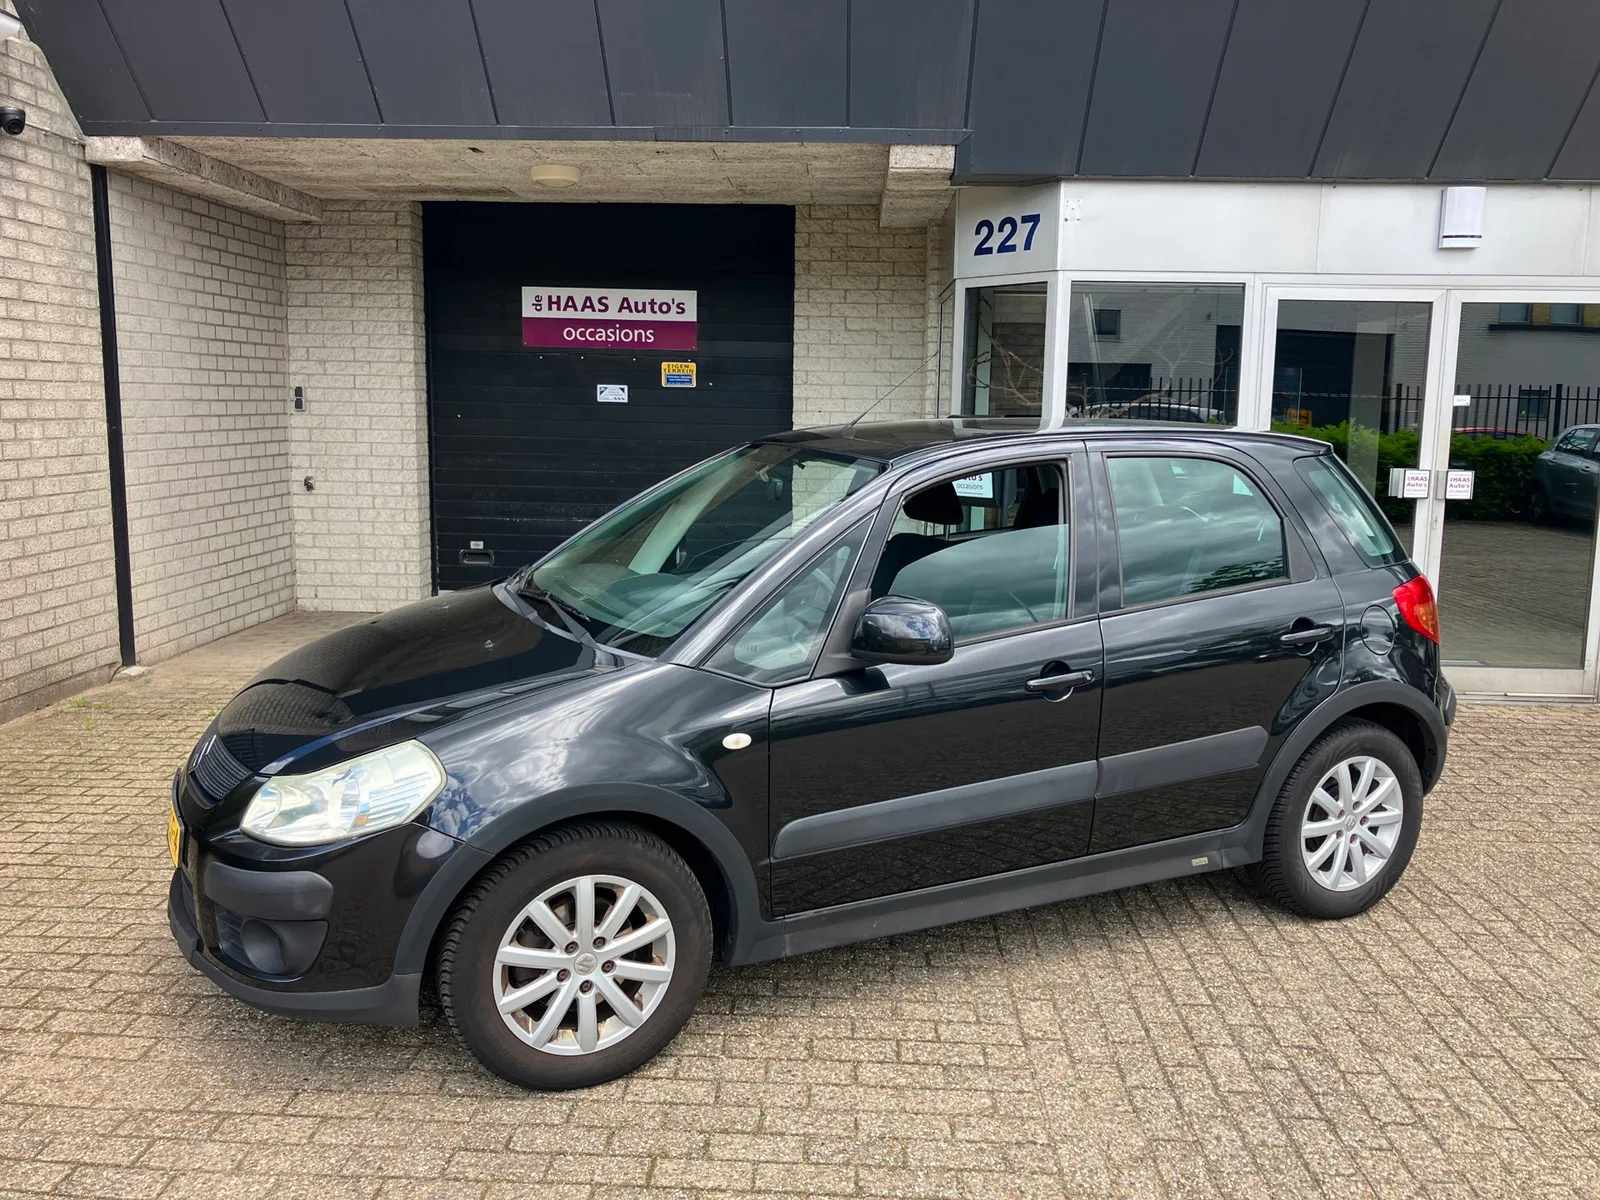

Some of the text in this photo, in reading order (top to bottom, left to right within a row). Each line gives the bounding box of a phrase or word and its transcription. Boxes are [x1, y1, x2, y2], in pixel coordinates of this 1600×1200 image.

[974, 213, 1041, 256] 227
[532, 294, 686, 315] de HAAS Auto's
[563, 323, 655, 343] occasions
